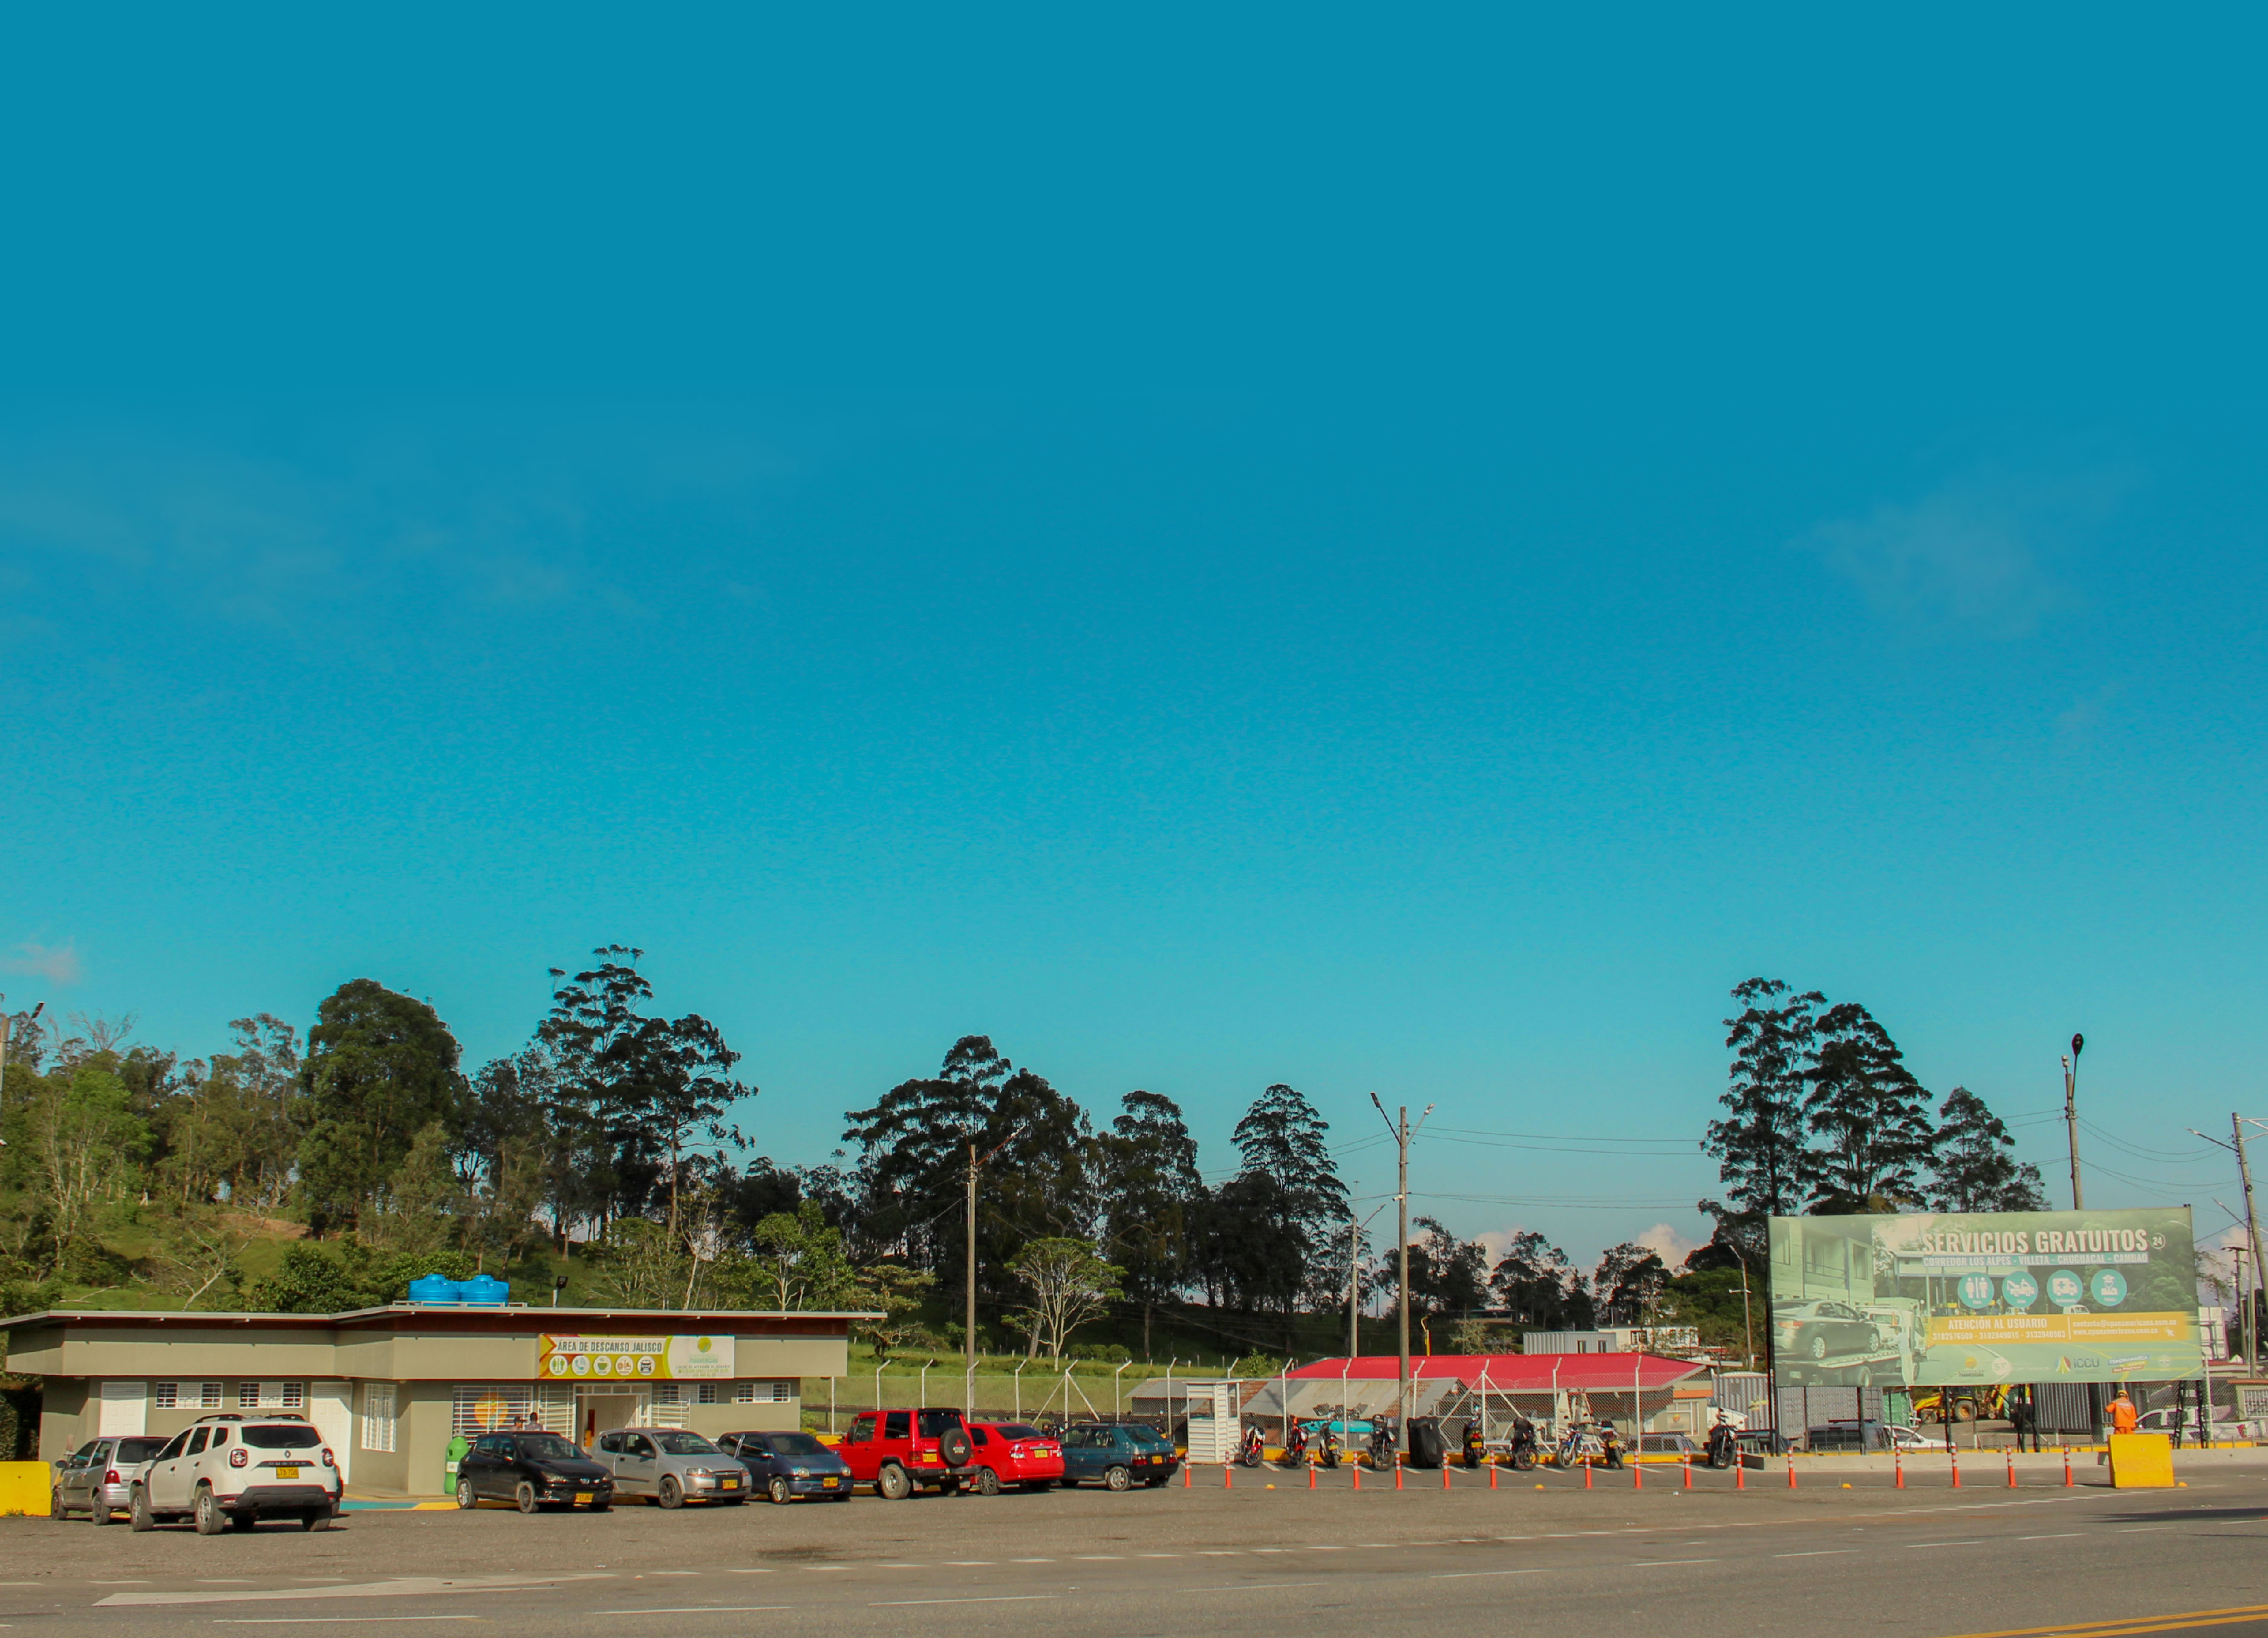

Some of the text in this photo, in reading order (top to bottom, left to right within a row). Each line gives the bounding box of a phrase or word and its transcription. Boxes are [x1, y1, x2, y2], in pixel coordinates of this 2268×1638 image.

[1923, 1228, 2149, 1255] SERVICIOS GRATUITOS
[2152, 1236, 2162, 1245] 24
[1923, 1256, 1967, 1267] CORREDOR
[1969, 1256, 1984, 1266] LOS
[1987, 1256, 2011, 1266] ALPES
[2018, 1255, 2049, 1265] VILLETA
[2058, 1254, 2105, 1264] CHUGUACAL
[2113, 1253, 2148, 1263] CAMBAO
[1948, 1317, 2047, 1330] ATENCIÓN AL USUARIO
[558, 1339, 662, 1352] ÁREA DE DESCANSO JALISCO
